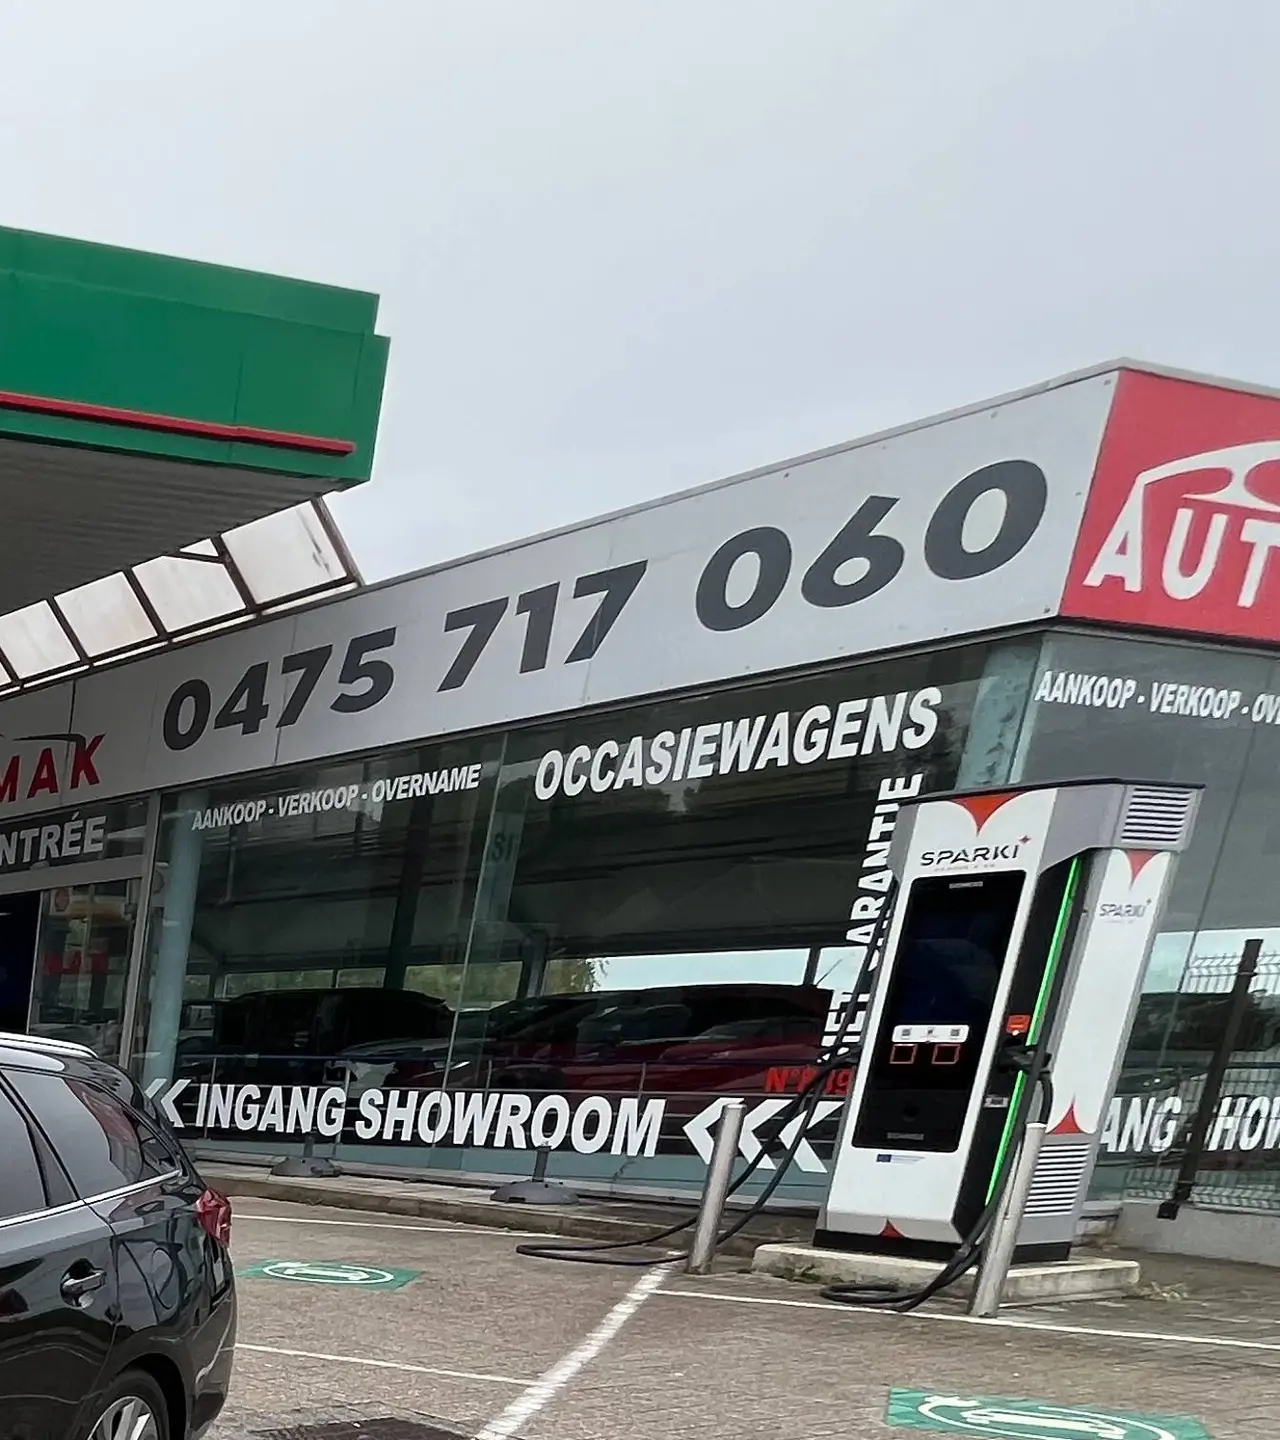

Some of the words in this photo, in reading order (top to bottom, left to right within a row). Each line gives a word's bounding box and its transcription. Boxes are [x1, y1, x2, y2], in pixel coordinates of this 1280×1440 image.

[163, 627, 397, 751] 0475
[437, 559, 649, 693] 717
[696, 459, 1048, 632] 060
[1035, 670, 1137, 709] AANKOOP
[1150, 681, 1242, 720] VERKOOP
[535, 687, 942, 800] OCCASIEWAGENS
[191, 800, 265, 831] AANKOOP
[278, 784, 358, 819] VERKOOP
[372, 763, 481, 803] OVERNAME
[842, 773, 924, 962] ARANTIE
[920, 845, 1019, 866] SPARKI
[196, 1083, 346, 1136] INGANG
[355, 1088, 667, 1157] SHOWROOM
[1100, 1096, 1182, 1152] ANG
